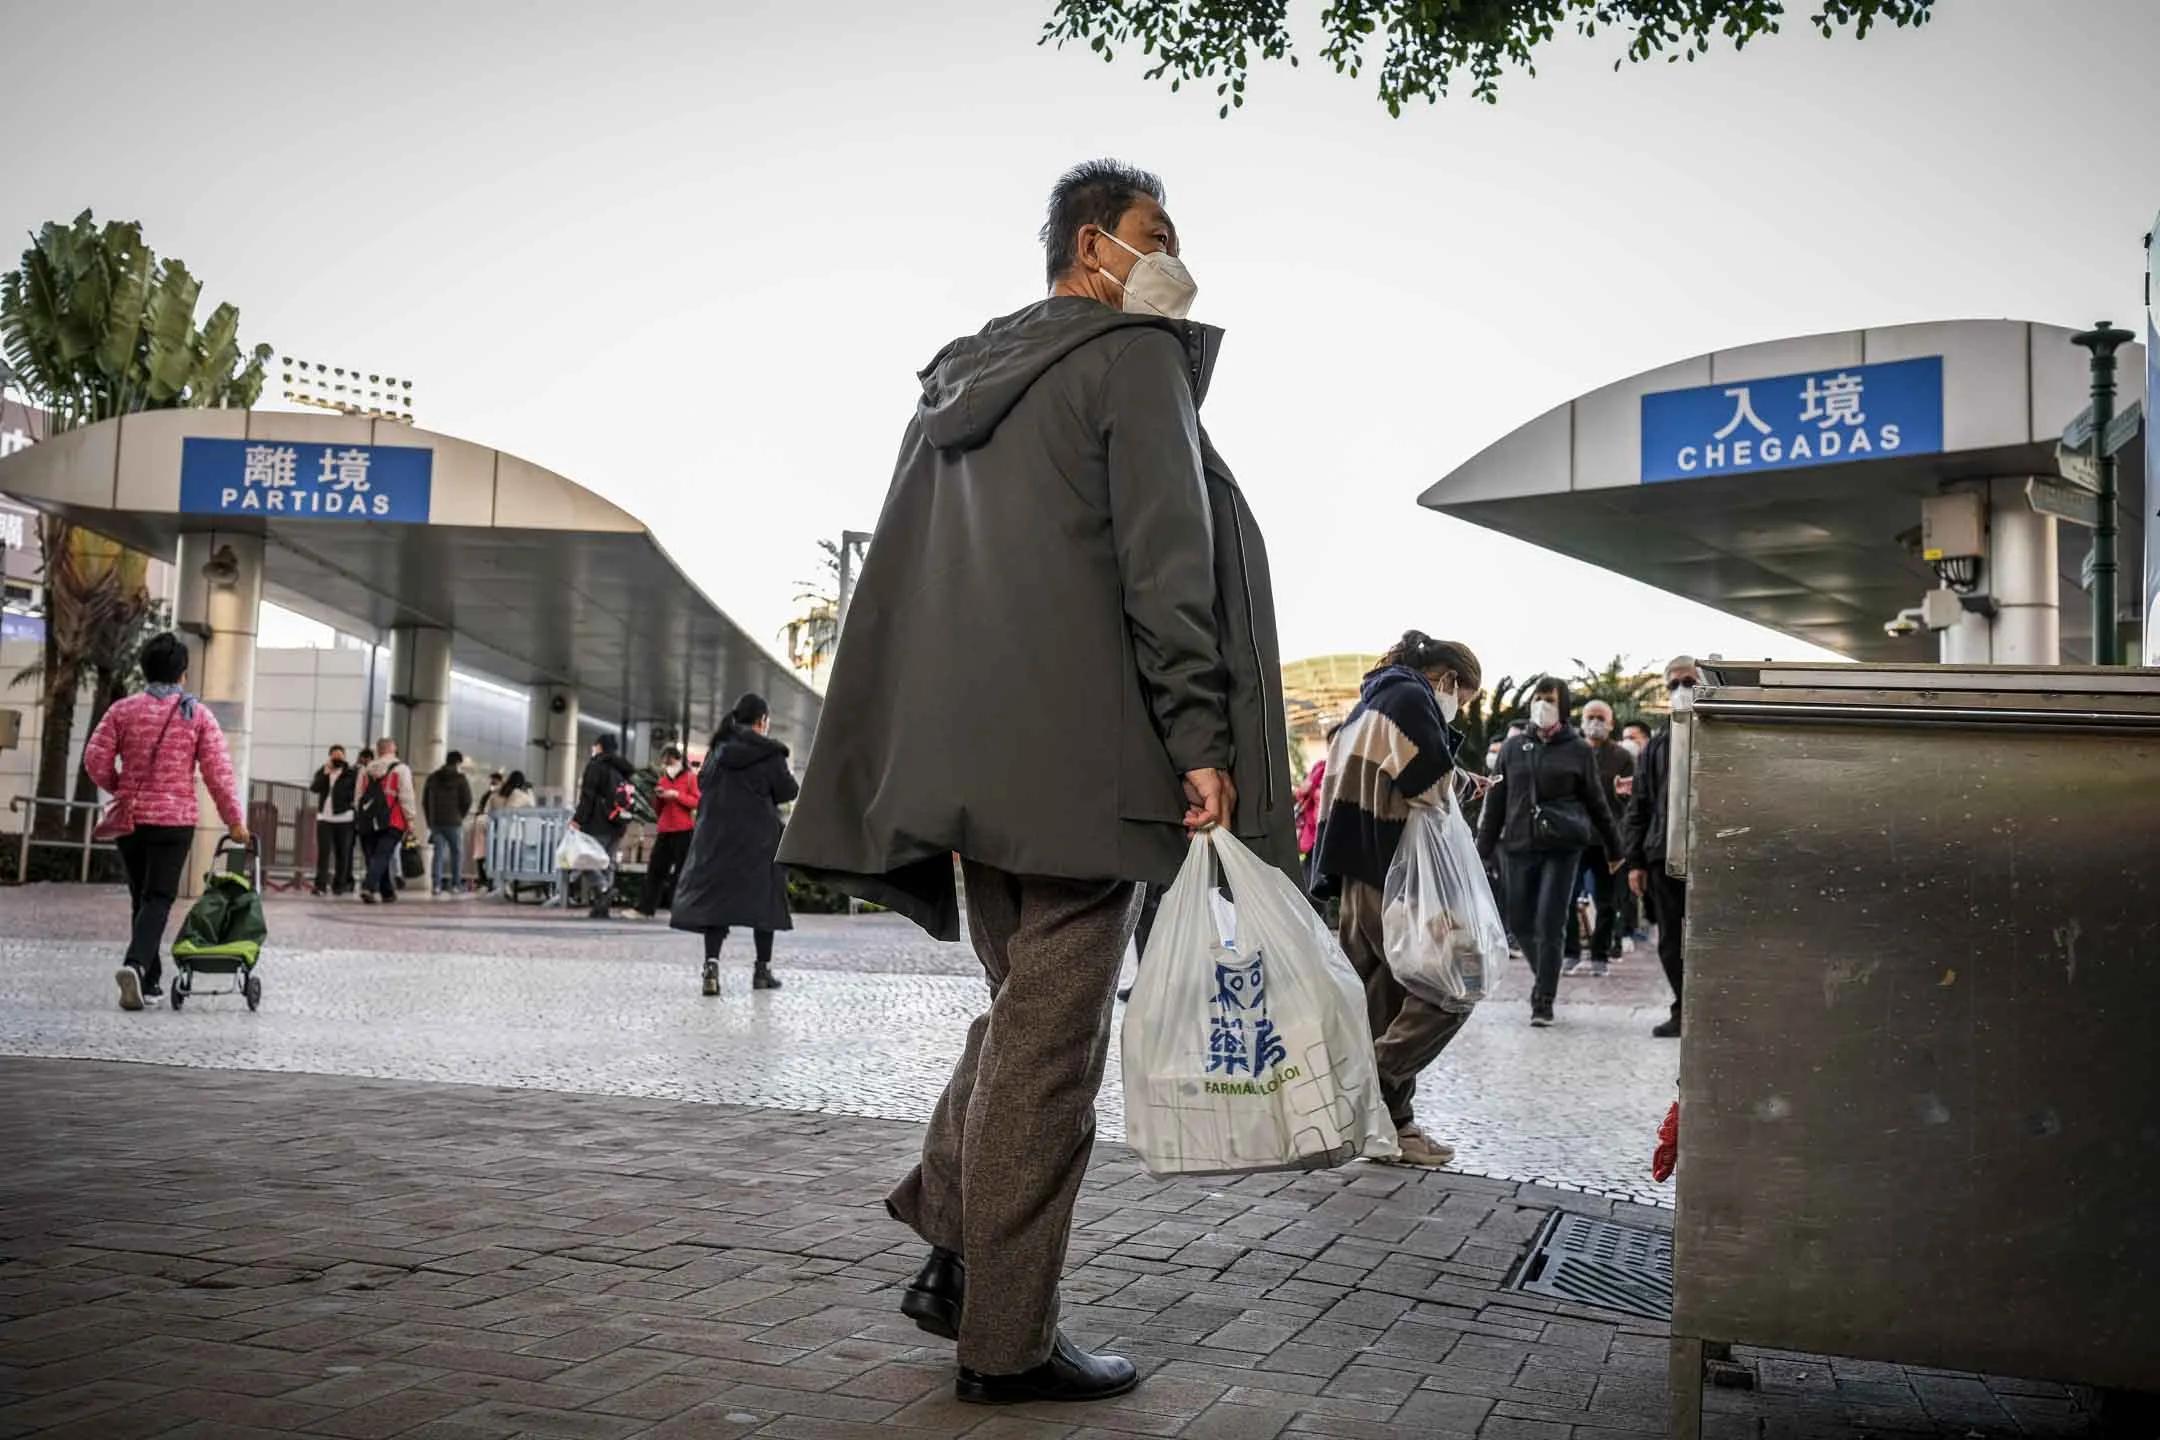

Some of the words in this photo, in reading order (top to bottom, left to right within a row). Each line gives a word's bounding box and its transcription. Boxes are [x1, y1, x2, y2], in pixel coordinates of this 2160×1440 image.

[1712, 373, 1866, 440] 入境
[243, 445, 371, 492] 離境
[1677, 424, 1901, 471] CHEGADAS
[221, 488, 389, 515] PARTIDAS
